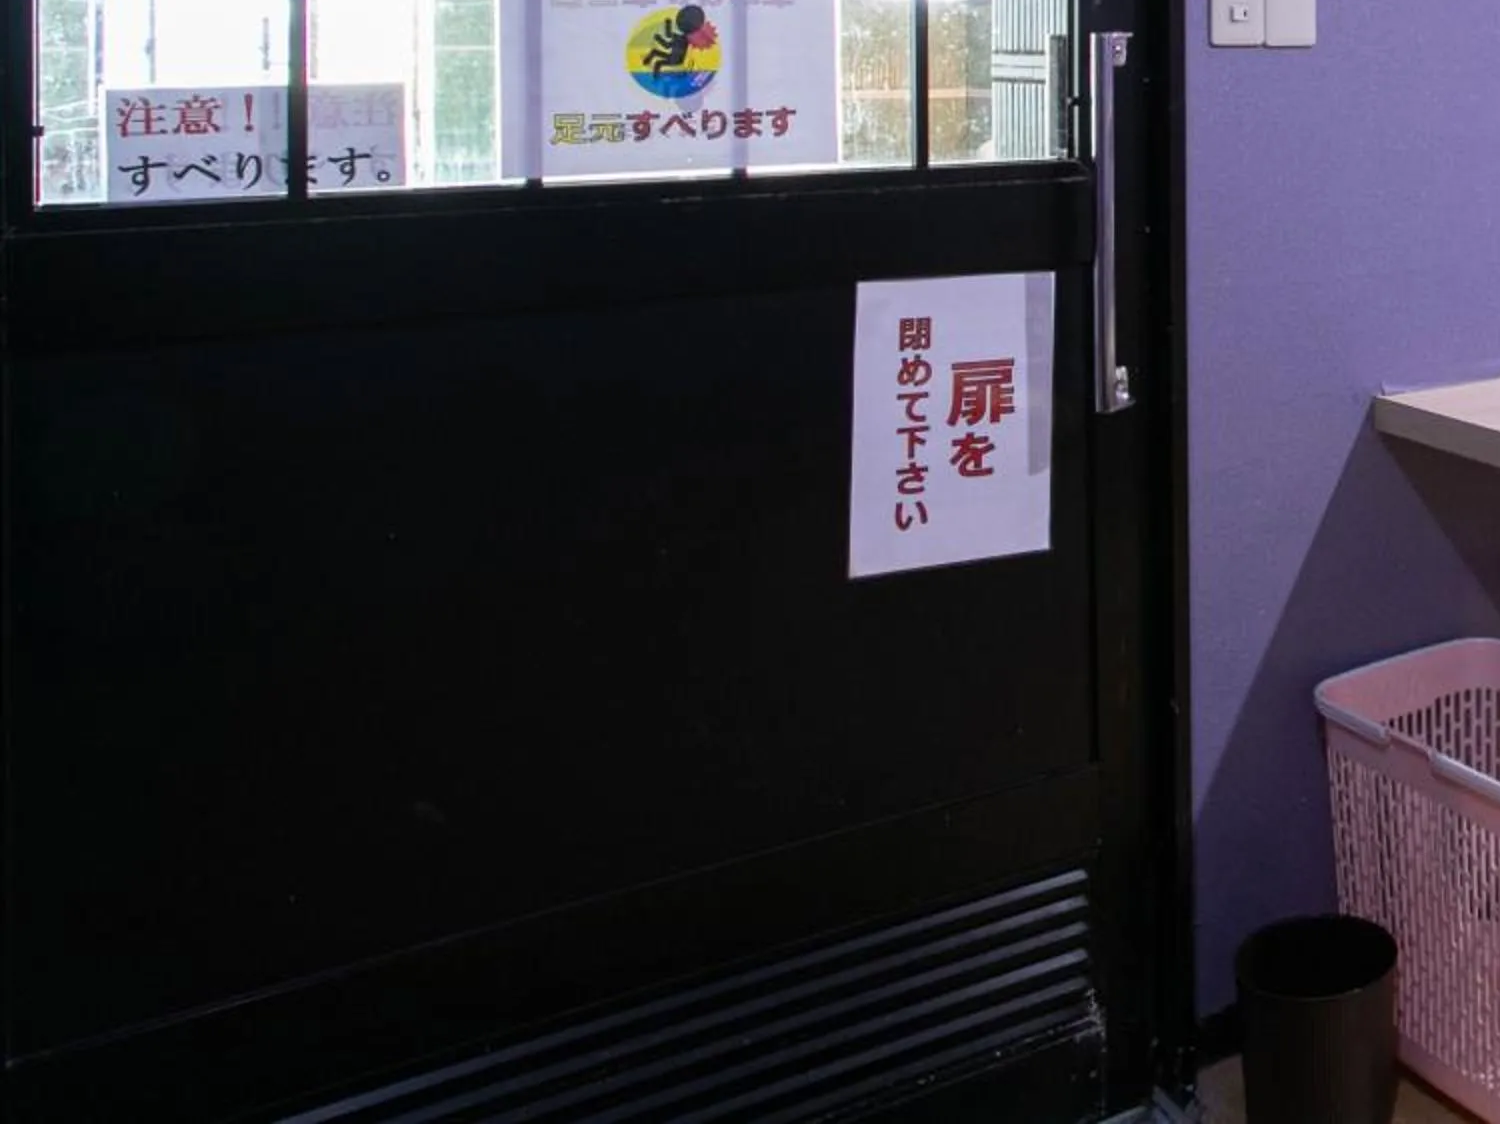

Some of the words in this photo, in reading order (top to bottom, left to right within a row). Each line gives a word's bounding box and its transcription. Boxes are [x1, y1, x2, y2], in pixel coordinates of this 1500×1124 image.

[116, 93, 255, 138] 注意！
[551, 106, 797, 145] 足元すべります
[895, 316, 933, 532] 閉めて下さい
[947, 357, 1016, 477] 扉を
